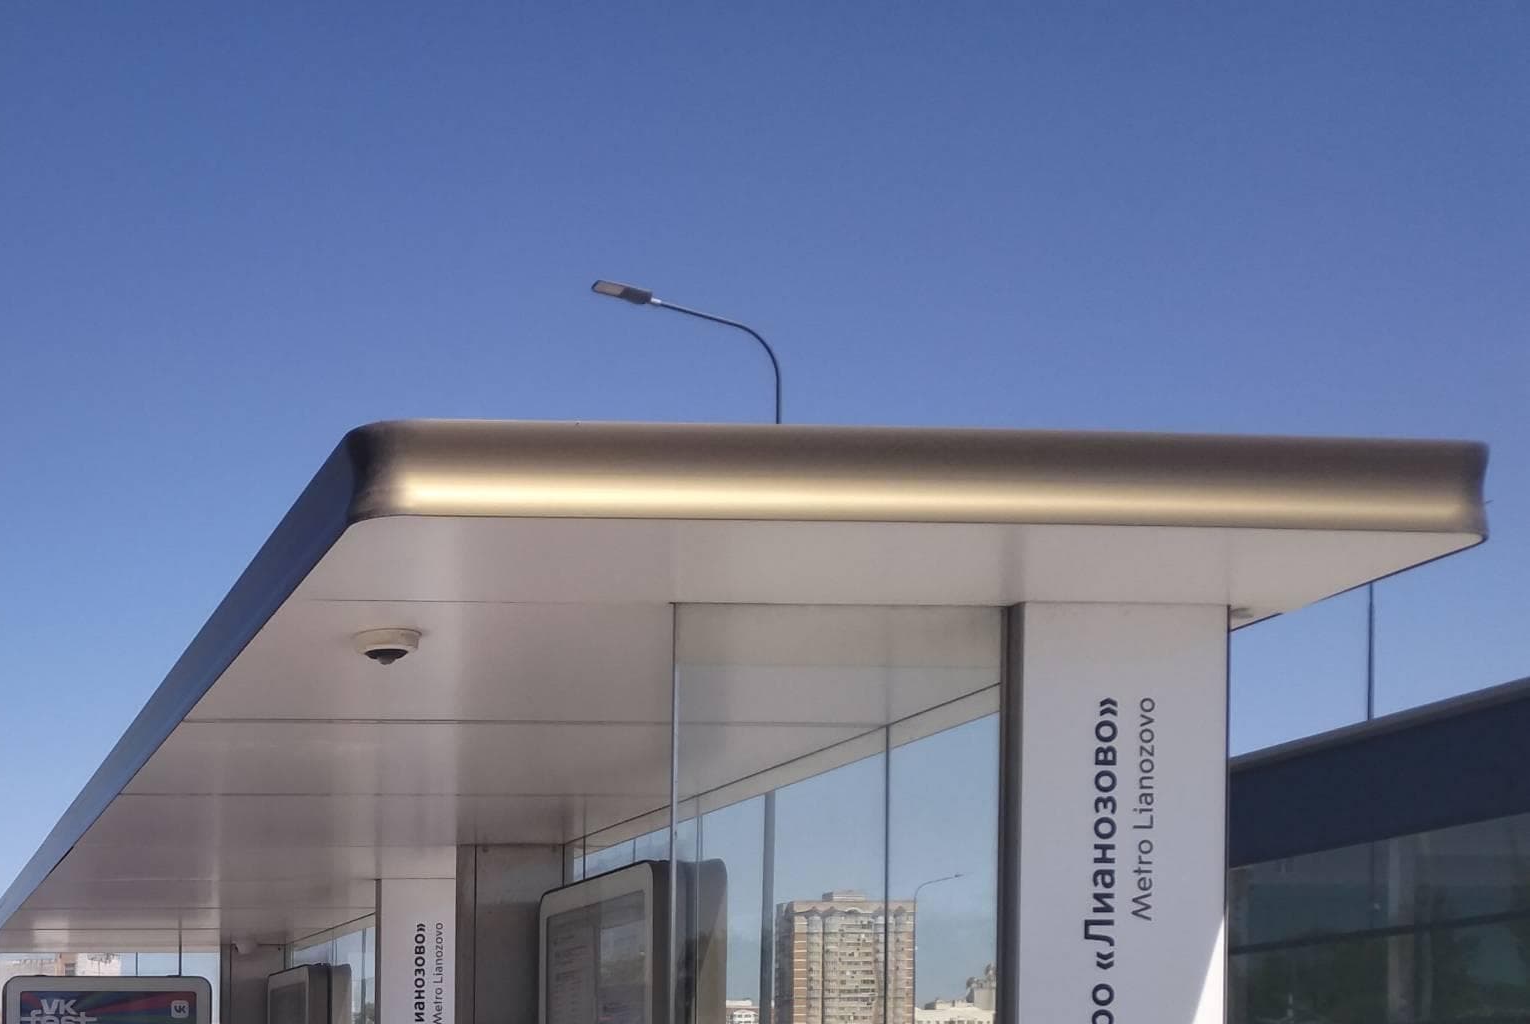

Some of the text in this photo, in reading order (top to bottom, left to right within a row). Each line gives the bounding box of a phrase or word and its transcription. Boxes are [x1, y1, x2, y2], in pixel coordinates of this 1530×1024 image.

[1083, 697, 1118, 971] «Лианозово»
[1131, 697, 1156, 921] Metro Lianozovo
[41, 999, 76, 1015] VK
[433, 922, 443, 984] Lianozovo
